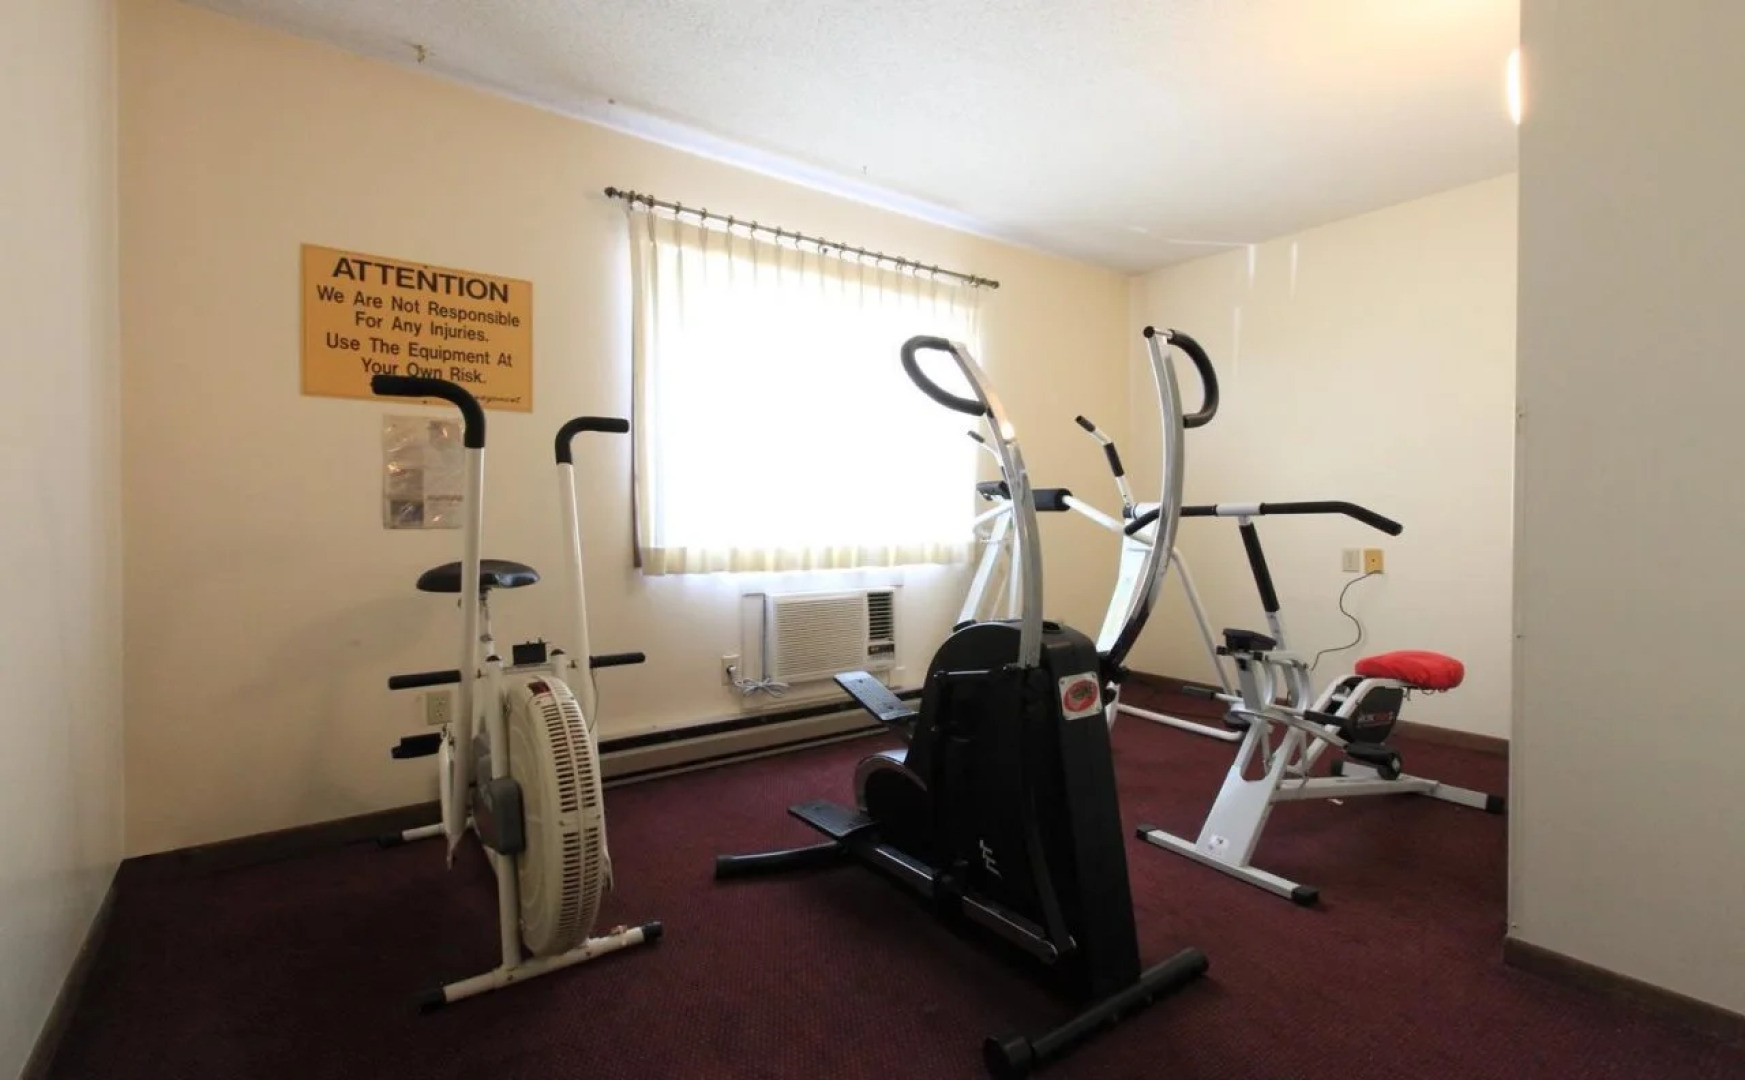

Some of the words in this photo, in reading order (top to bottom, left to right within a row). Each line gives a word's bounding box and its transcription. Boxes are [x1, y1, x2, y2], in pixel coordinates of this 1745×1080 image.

[332, 257, 509, 303] ATTENTION
[317, 285, 344, 303] We
[353, 291, 383, 309] Are
[391, 296, 420, 314] Not
[428, 301, 520, 327] Responsible
[355, 311, 383, 329] For
[391, 316, 422, 337] Any
[430, 321, 489, 343] Injuries.
[326, 332, 360, 350] Use
[369, 337, 399, 355] The
[408, 342, 490, 366] Equipment
[497, 352, 512, 368] At
[361, 357, 398, 375] Your
[407, 362, 443, 380] Own
[450, 367, 487, 384] Risk.
